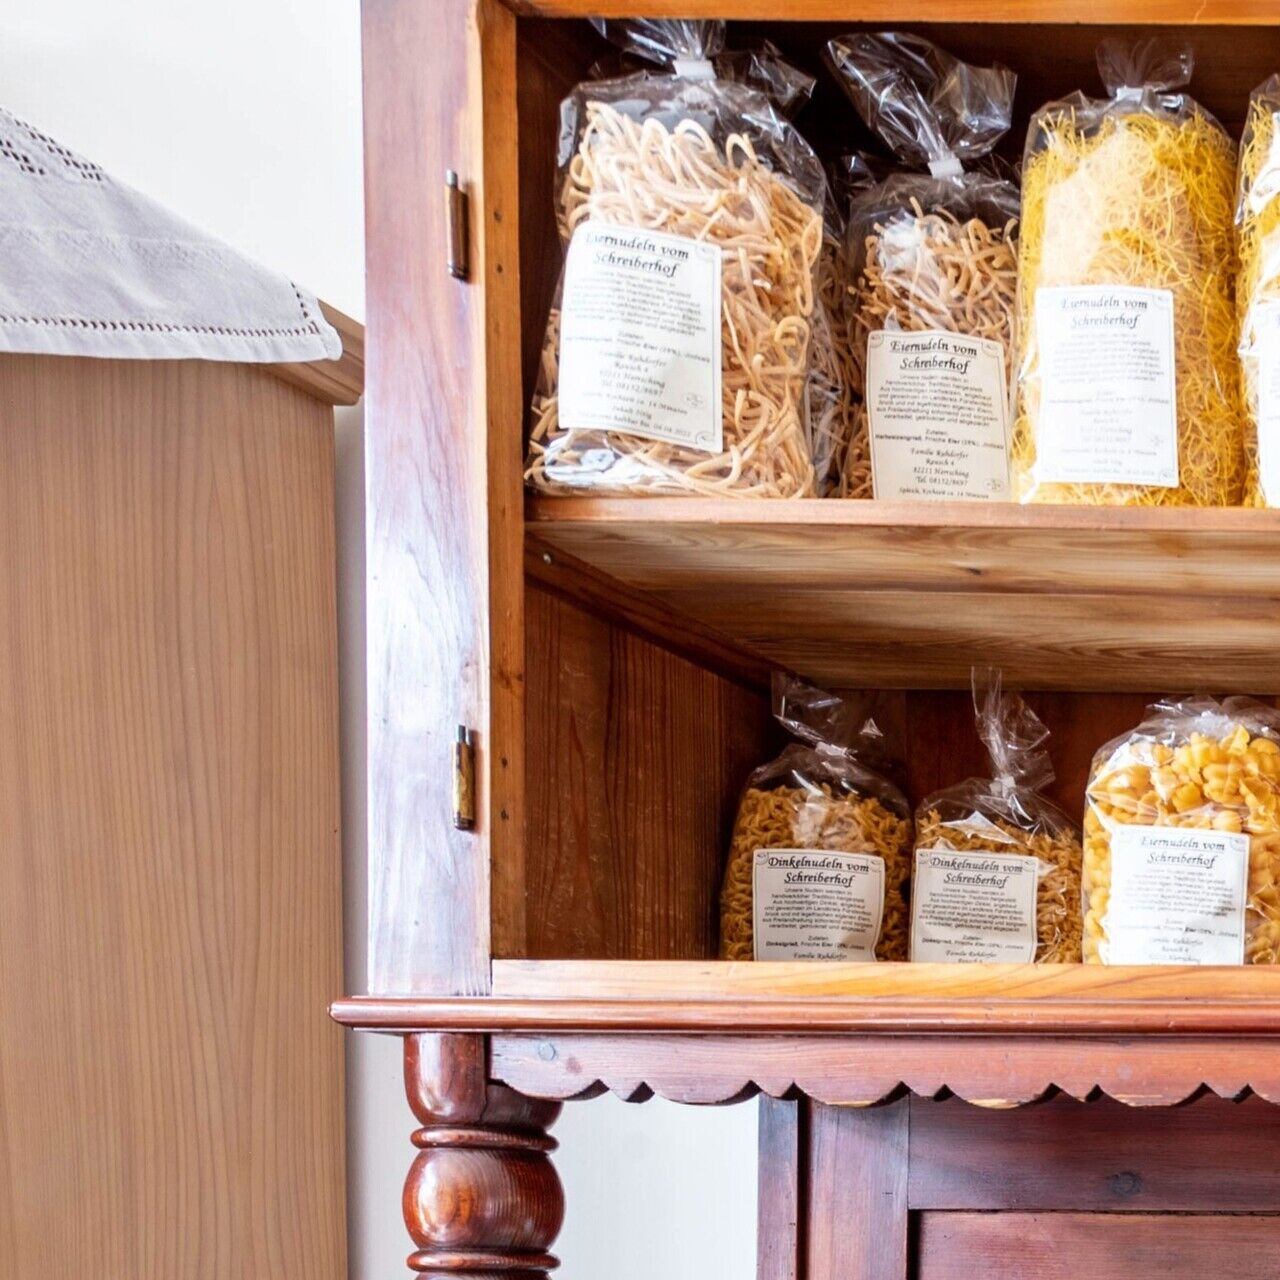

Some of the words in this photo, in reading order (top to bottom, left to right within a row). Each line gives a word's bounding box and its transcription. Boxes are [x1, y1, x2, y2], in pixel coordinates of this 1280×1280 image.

[660, 244, 690, 260] vom
[593, 251, 678, 277] Schreiberhof
[1124, 300, 1148, 309] vom
[1072, 312, 1141, 329] Schreiberhof
[890, 338, 948, 354] Eiernudeln
[953, 345, 978, 356] vom
[900, 355, 971, 374] Schreiberhof
[1203, 841, 1225, 851] vom
[767, 856, 842, 871] Dinkelnudeln
[846, 863, 869, 873] vom
[930, 857, 999, 871] Dinkelnudeln
[1003, 864, 1023, 874] vom
[1147, 852, 1216, 869] Schreiberhof
[784, 871, 855, 888] Schreiberhof
[943, 872, 1009, 889] Schreiberhof
